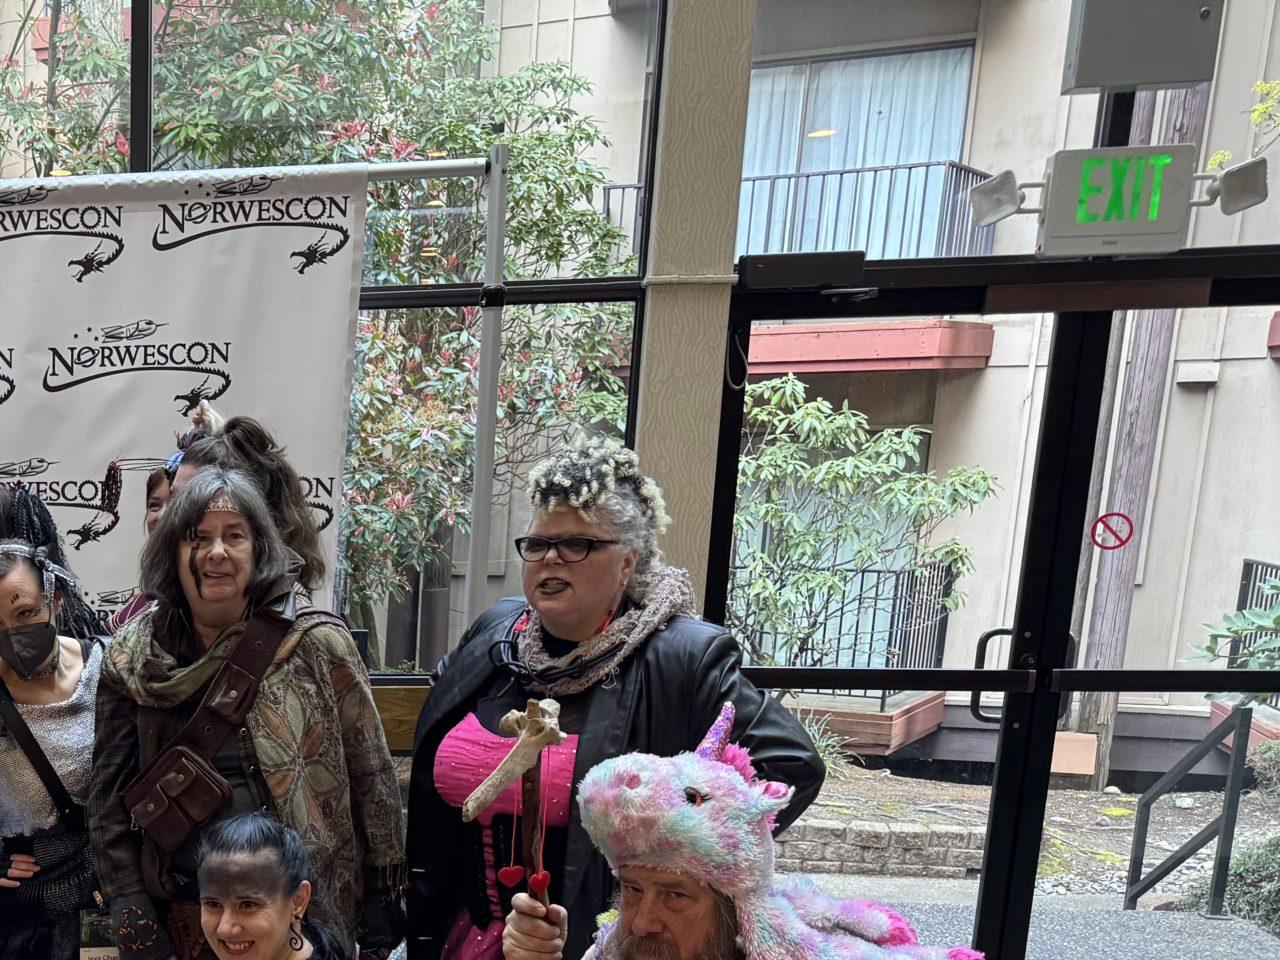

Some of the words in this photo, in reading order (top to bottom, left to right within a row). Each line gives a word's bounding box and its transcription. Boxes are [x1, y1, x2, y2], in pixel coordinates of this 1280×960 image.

[1076, 155, 1172, 222] EXIT
[158, 195, 350, 234] NORWESCON
[48, 341, 231, 376] NORWESCON
